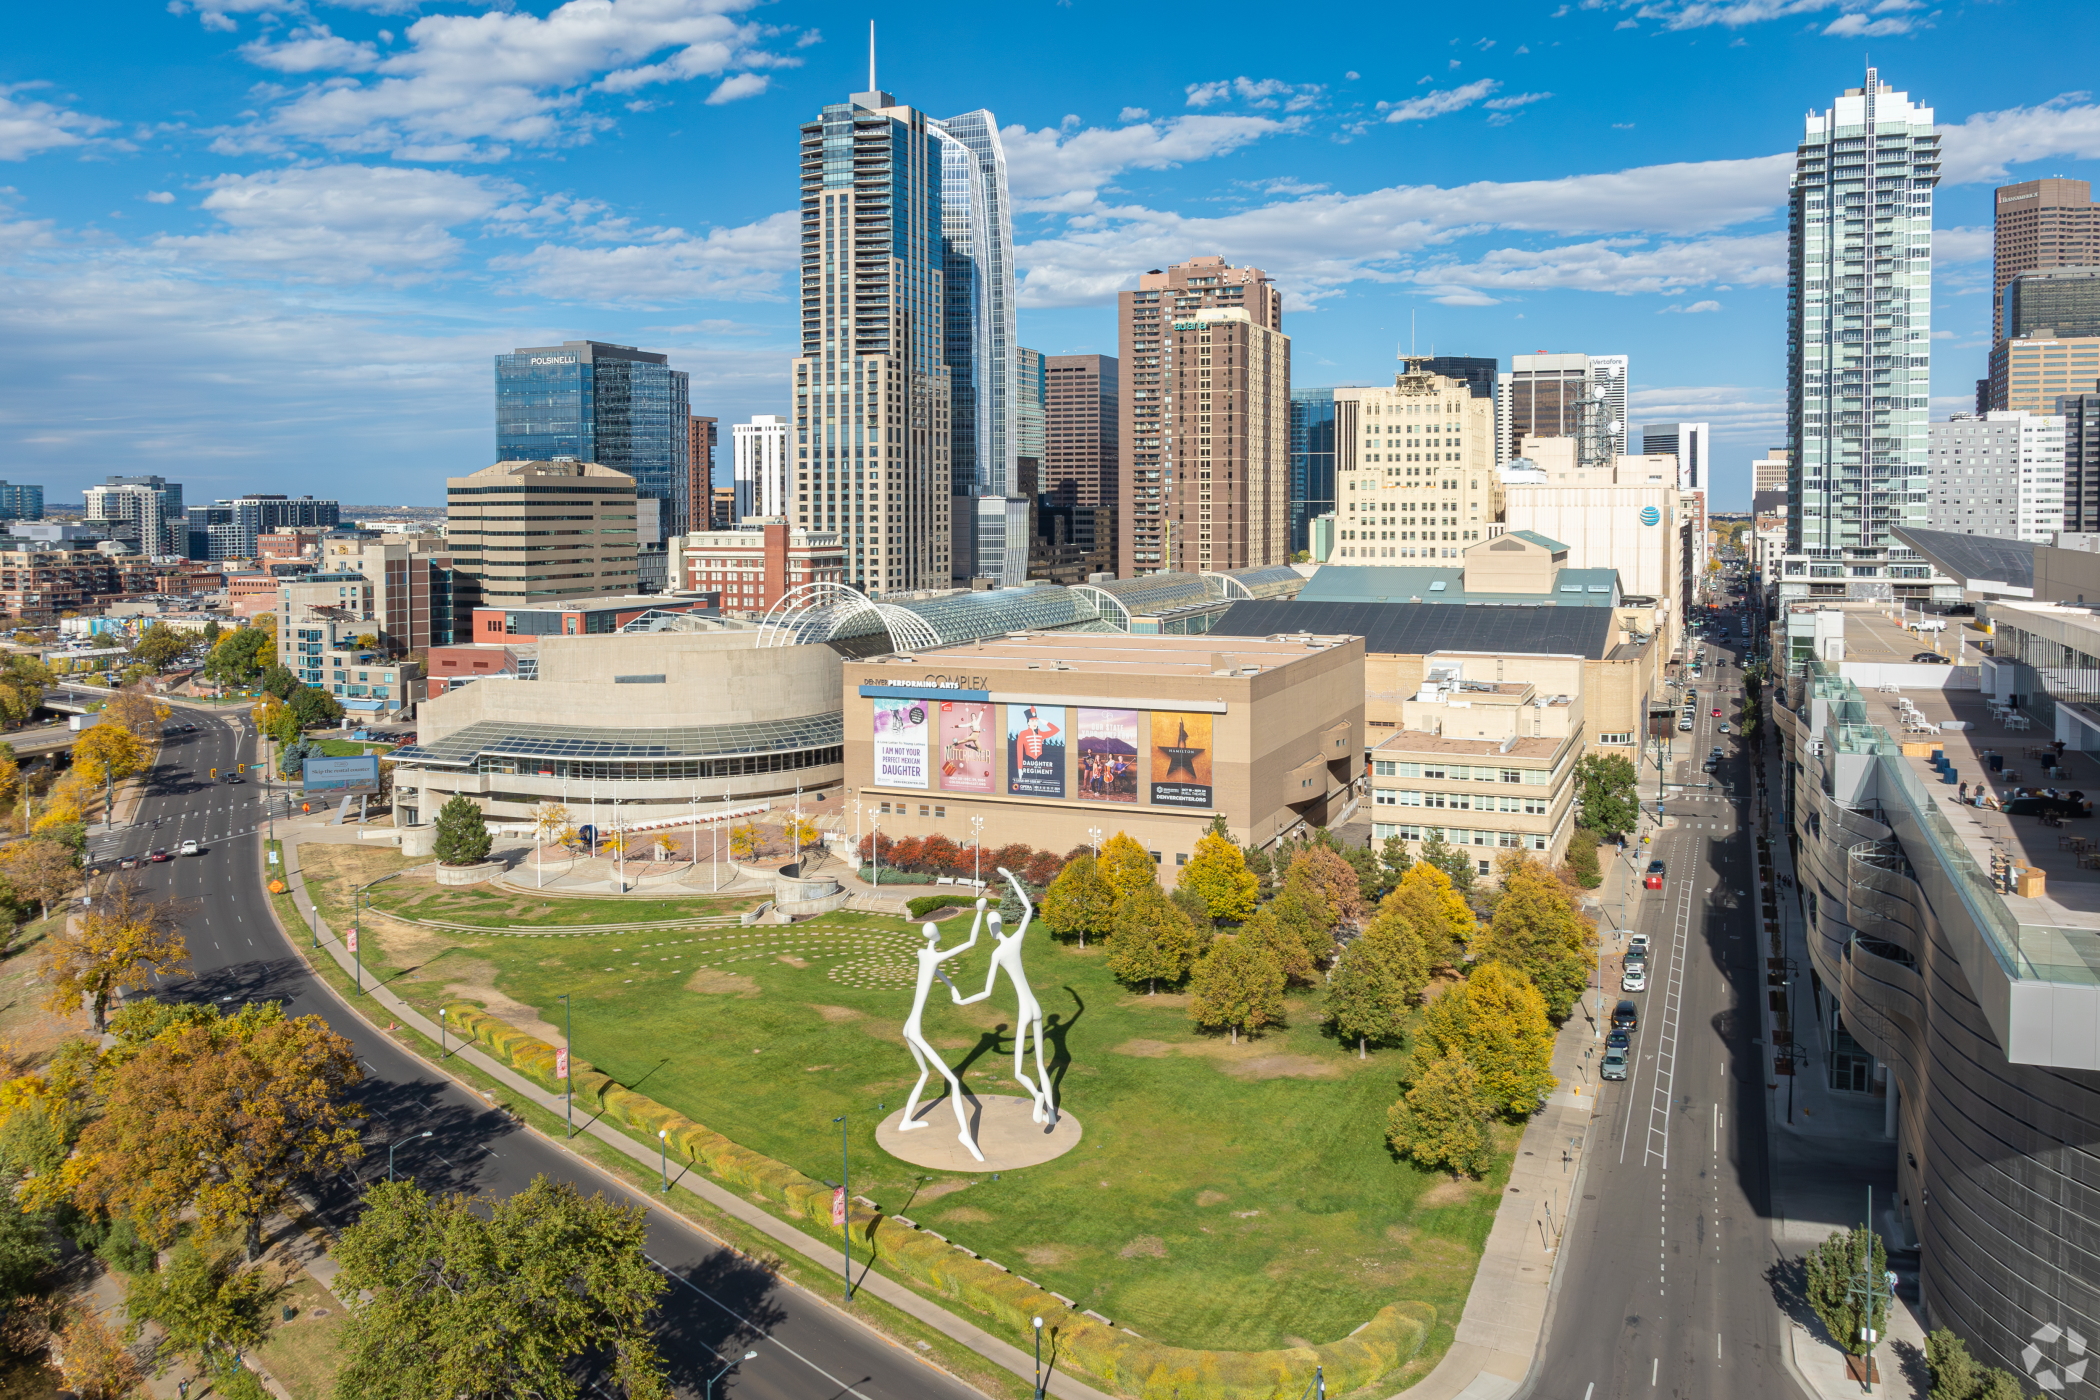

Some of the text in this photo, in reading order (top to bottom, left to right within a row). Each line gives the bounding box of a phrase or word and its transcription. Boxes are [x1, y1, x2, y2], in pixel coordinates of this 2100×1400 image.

[531, 356, 576, 365] POLSINELLI
[864, 674, 988, 690] DENVER PERFORMING ARTS COMPLEX
[885, 747, 894, 755] AM
[894, 747, 905, 755] NOT
[905, 748, 921, 756] YOUR
[901, 757, 921, 765] MEXICAN
[882, 764, 921, 777] DAUGHTER
